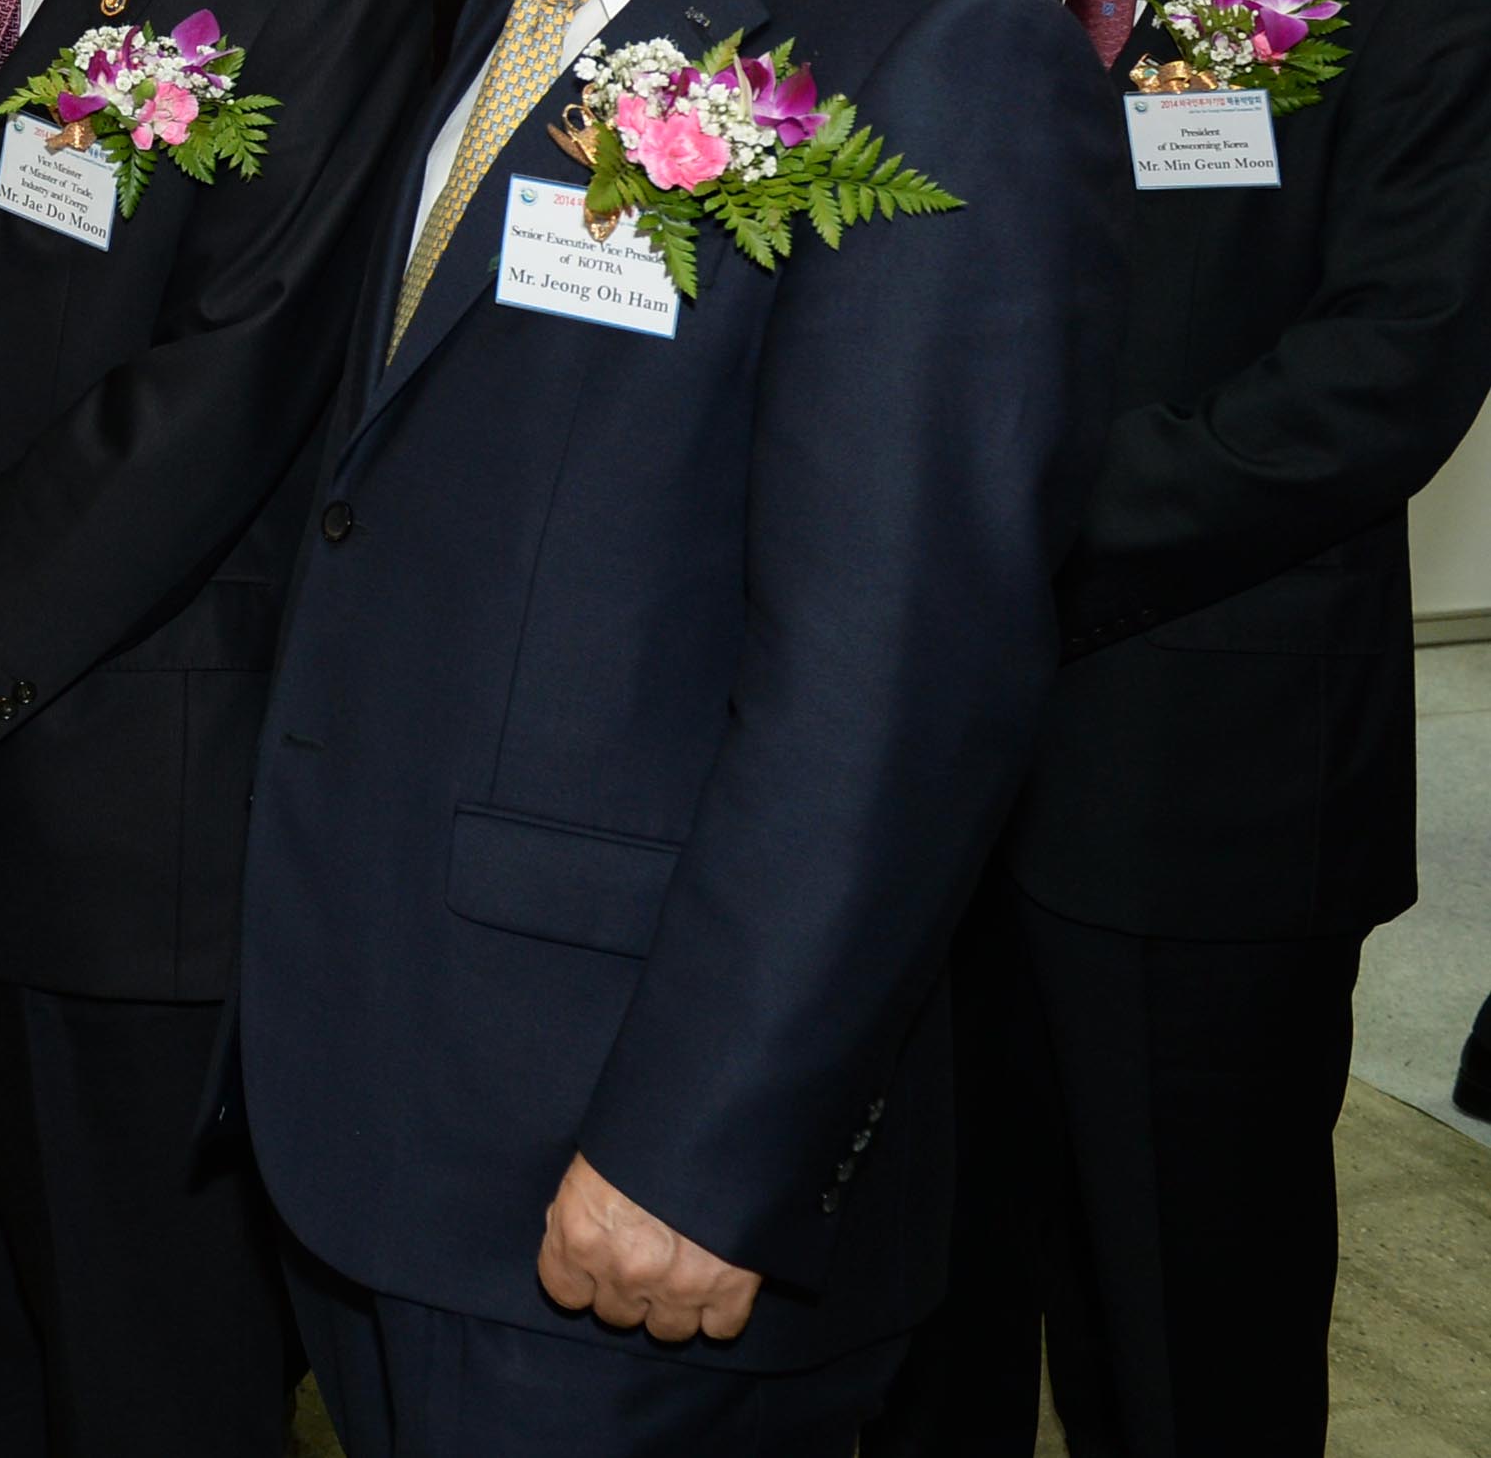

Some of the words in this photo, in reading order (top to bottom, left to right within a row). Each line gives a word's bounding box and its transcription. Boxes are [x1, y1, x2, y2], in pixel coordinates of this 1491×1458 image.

[1181, 128, 1220, 138] President
[1157, 142, 1167, 151] of
[1223, 140, 1249, 150] Korea
[1138, 160, 1160, 172] Mr.
[1164, 159, 1191, 172] Min
[1194, 158, 1231, 171] Geun
[1234, 157, 1274, 170] Moon
[21, 194, 43, 213] Jae
[46, 204, 66, 222] Do
[68, 212, 107, 239] Moon
[511, 225, 544, 242] Senior
[546, 231, 596, 252] Executive
[600, 241, 623, 258] Vice
[559, 253, 572, 265] of
[578, 256, 623, 276] KOTRA
[508, 266, 536, 286] Mr.
[541, 273, 592, 302] Jeong
[597, 285, 622, 304] Oh
[627, 291, 669, 314] Ham
